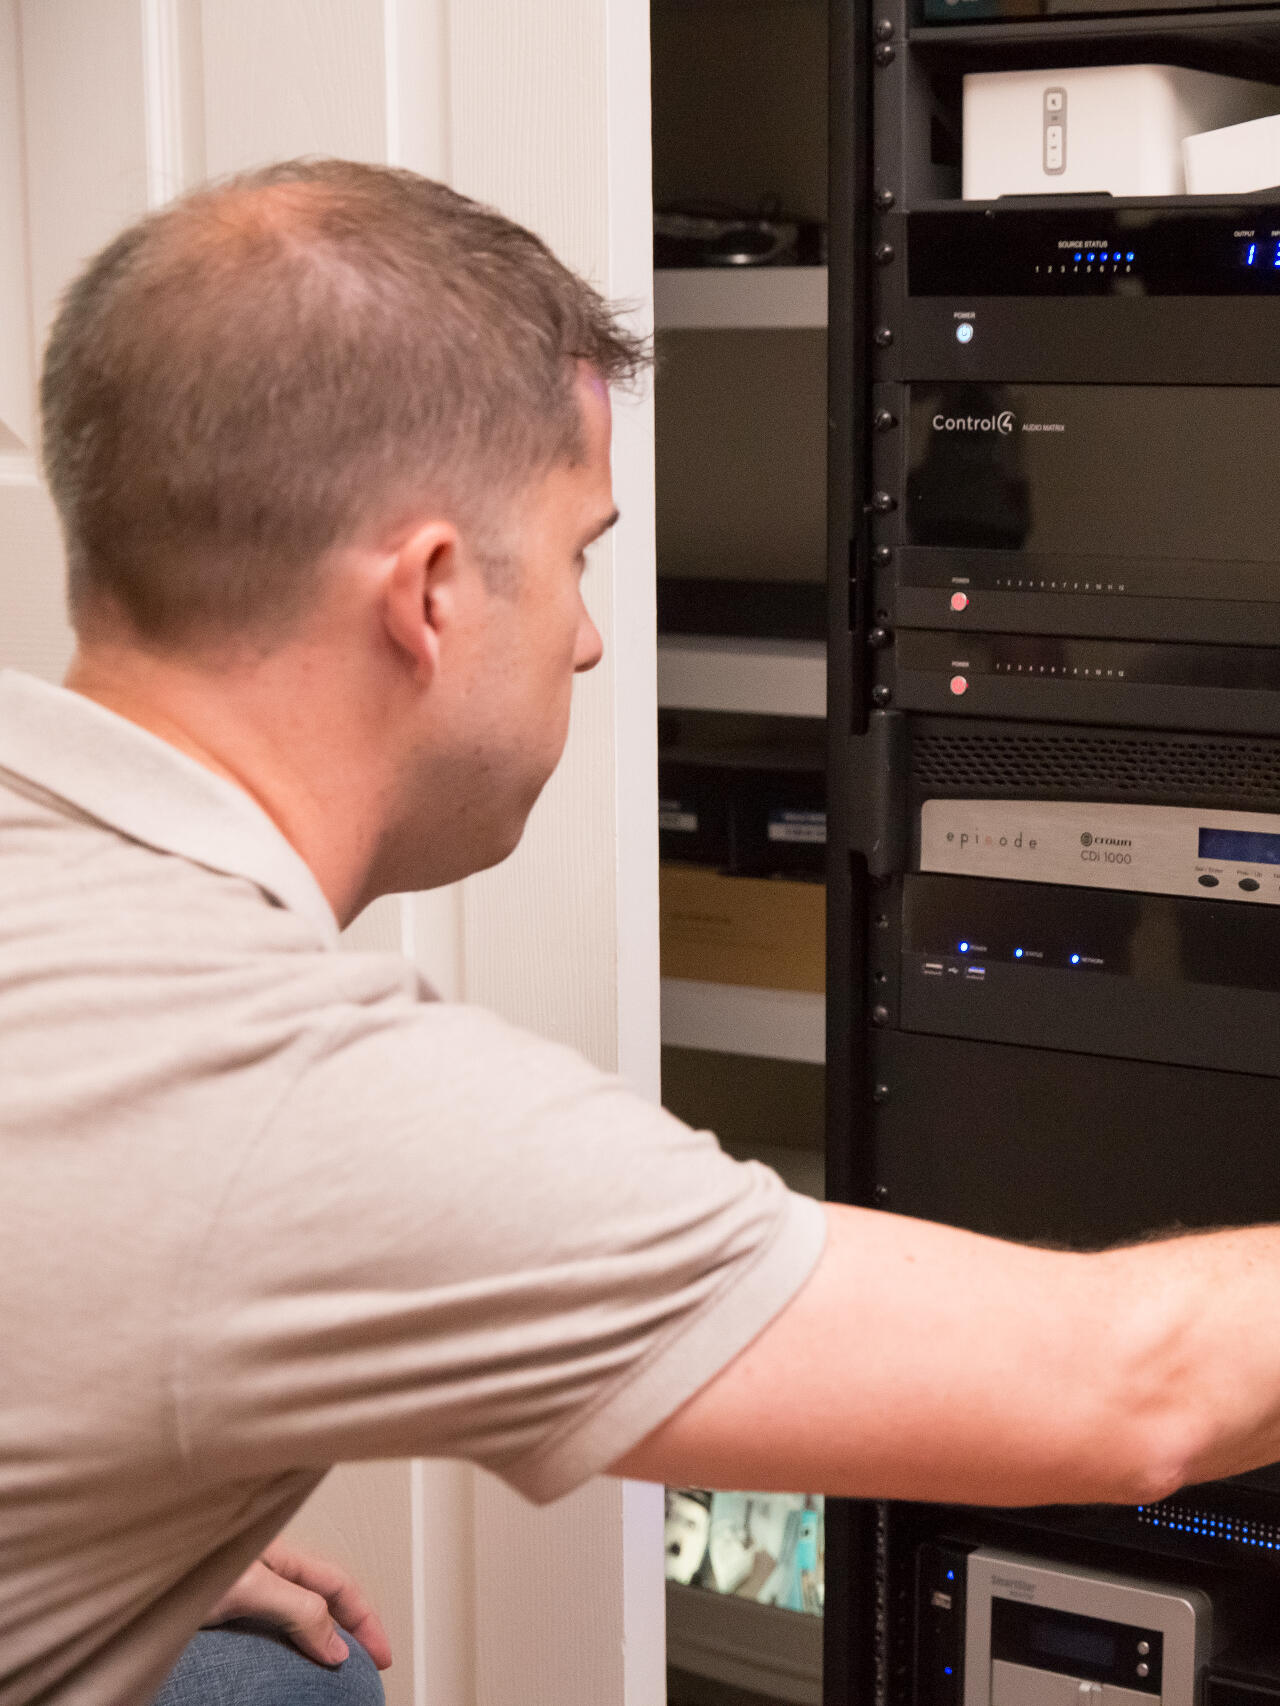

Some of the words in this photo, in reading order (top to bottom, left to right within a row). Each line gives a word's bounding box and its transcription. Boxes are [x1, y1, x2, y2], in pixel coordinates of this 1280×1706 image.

[1233, 230, 1255, 238] OUTPUT
[1057, 240, 1083, 249] SOURCE
[1084, 240, 1108, 249] STATUS
[1246, 243, 1256, 266] 1
[932, 411, 1017, 435] Control4
[1104, 851, 1132, 865] 1000
